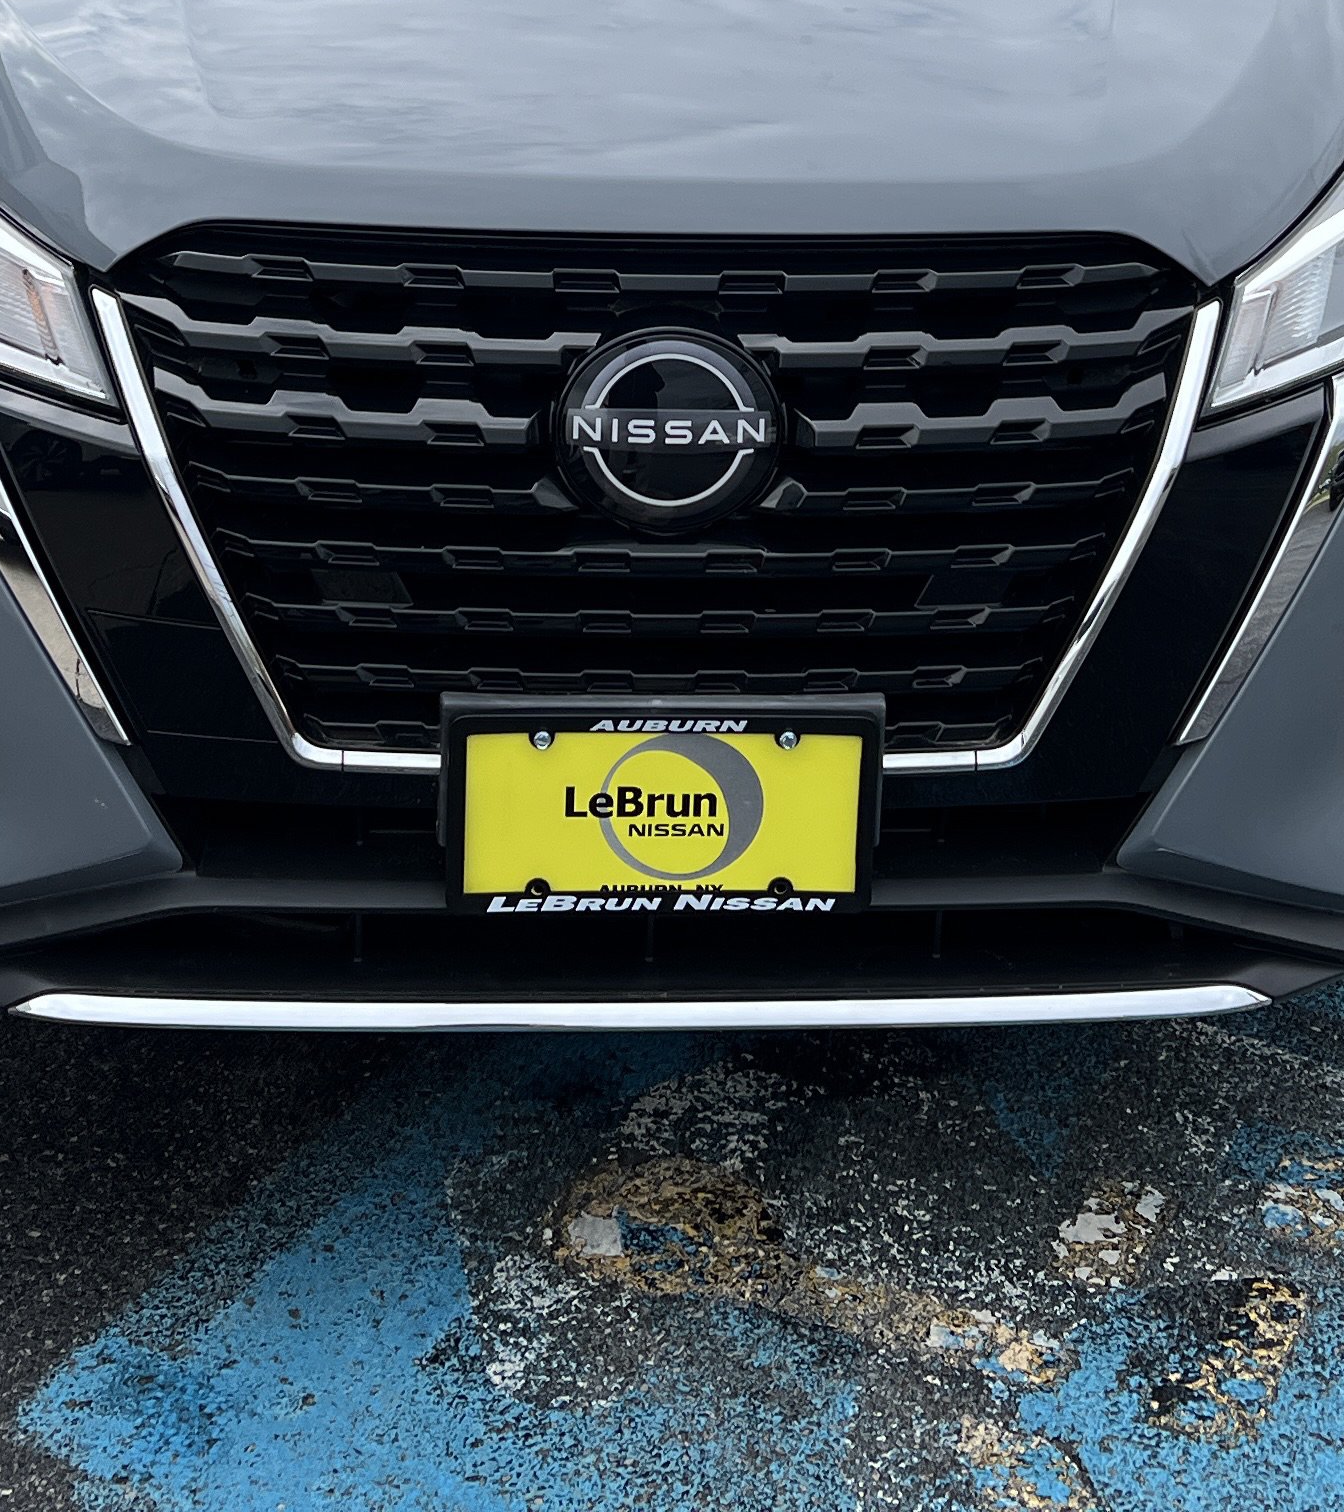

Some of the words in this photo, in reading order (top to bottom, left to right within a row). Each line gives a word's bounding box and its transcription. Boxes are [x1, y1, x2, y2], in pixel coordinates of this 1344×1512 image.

[572, 415, 765, 445] NISSAN
[590, 719, 747, 733] AUBURN
[564, 786, 717, 818] LeBrun
[628, 823, 724, 837] NISSAN
